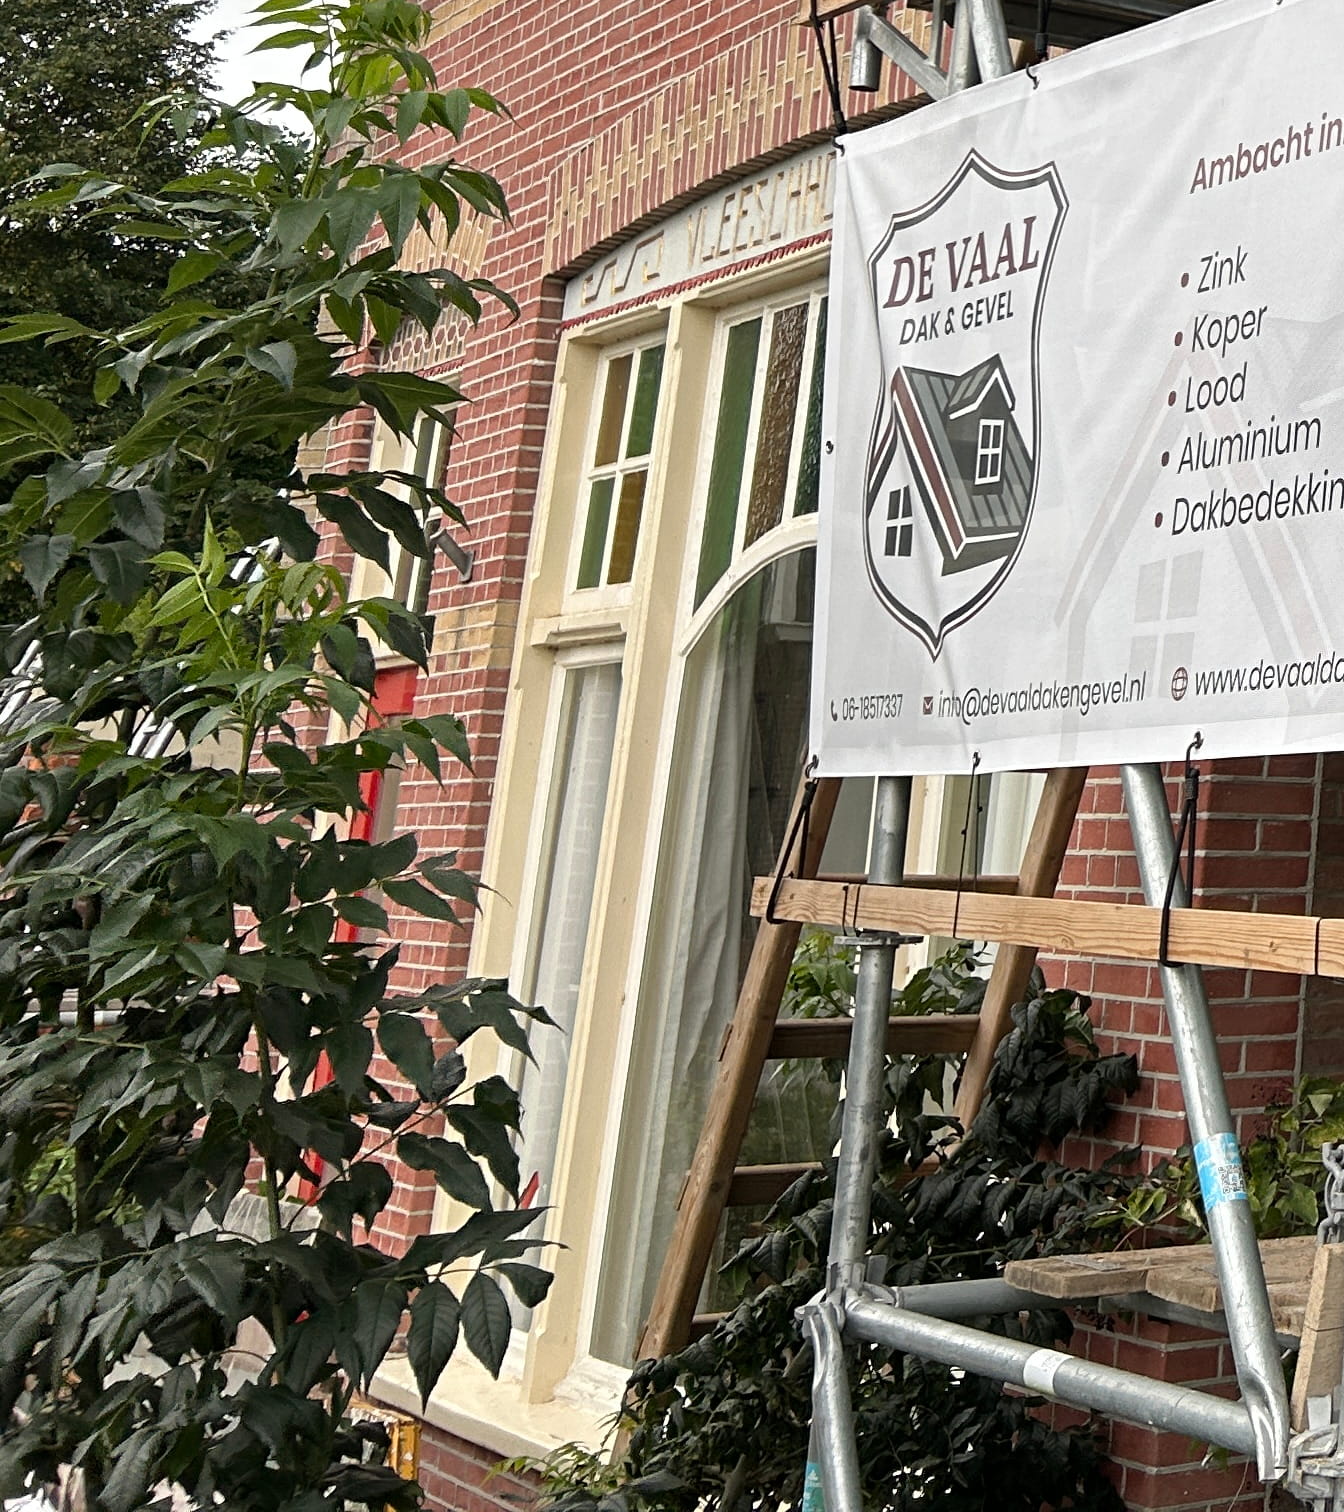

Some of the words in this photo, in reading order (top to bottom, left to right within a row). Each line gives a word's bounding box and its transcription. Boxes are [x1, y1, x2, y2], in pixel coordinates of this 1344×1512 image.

[1190, 121, 1314, 194] Ambacht
[882, 247, 936, 309] DE
[945, 216, 1040, 293] VAAL
[1197, 245, 1248, 294] Zink
[899, 310, 941, 345] DAK
[944, 307, 955, 336] &
[961, 290, 1014, 331] GEVEL
[1191, 305, 1268, 358] Koper
[1185, 361, 1248, 414] Lood
[1176, 414, 1322, 475] Aluminium
